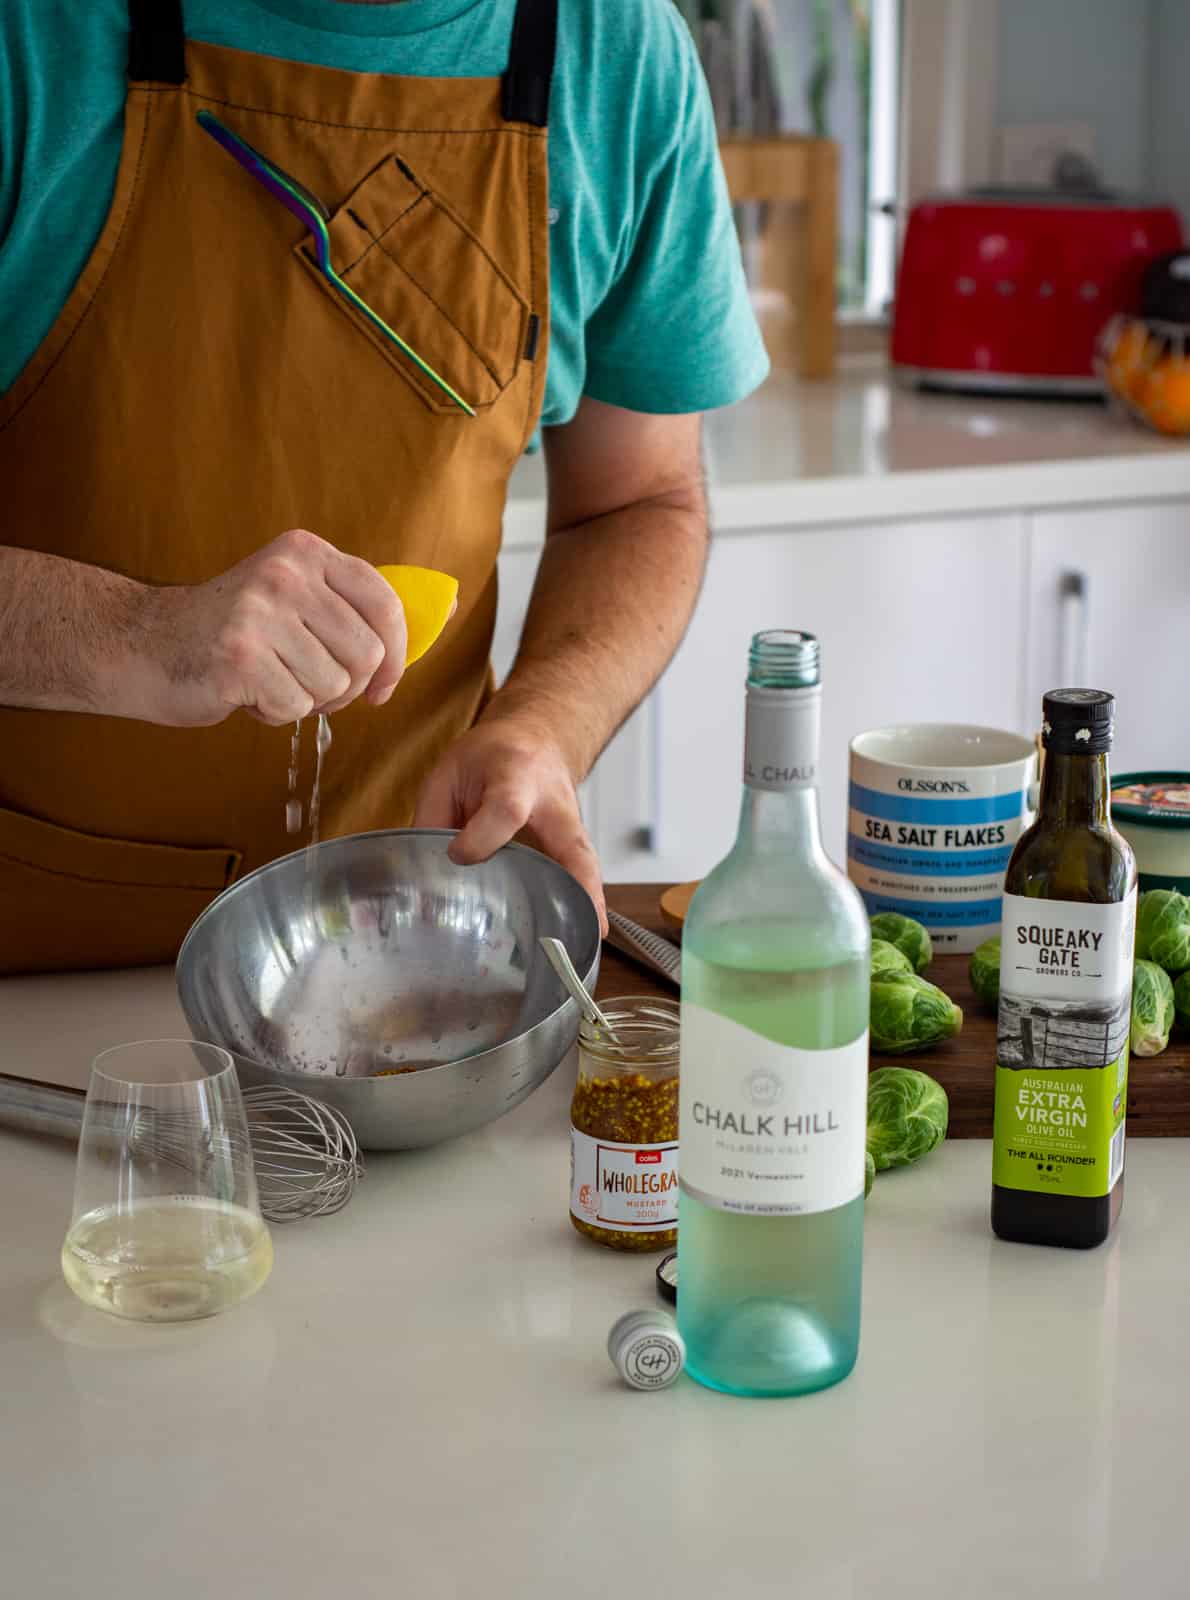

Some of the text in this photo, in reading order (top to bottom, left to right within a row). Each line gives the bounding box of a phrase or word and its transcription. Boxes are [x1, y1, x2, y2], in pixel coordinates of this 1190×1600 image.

[865, 819, 1005, 847] SEA SALT FLAKES
[1017, 925, 1103, 951] SQUEAKY
[1039, 948, 1081, 967] GATE
[1036, 967, 1069, 976] GROWERS
[1022, 1078, 1084, 1094] AUSTRALIAN
[1018, 1088, 1086, 1111] EXTRA
[692, 1101, 841, 1136] CHALK HILL
[1015, 1105, 1088, 1128] VIRGIN
[1026, 1123, 1075, 1138] OLIVE OIL
[1007, 1149, 1097, 1166] THE ALL ROUNDER
[603, 1168, 678, 1194] WHOLEGRA
[720, 1166, 744, 1177] 2021
